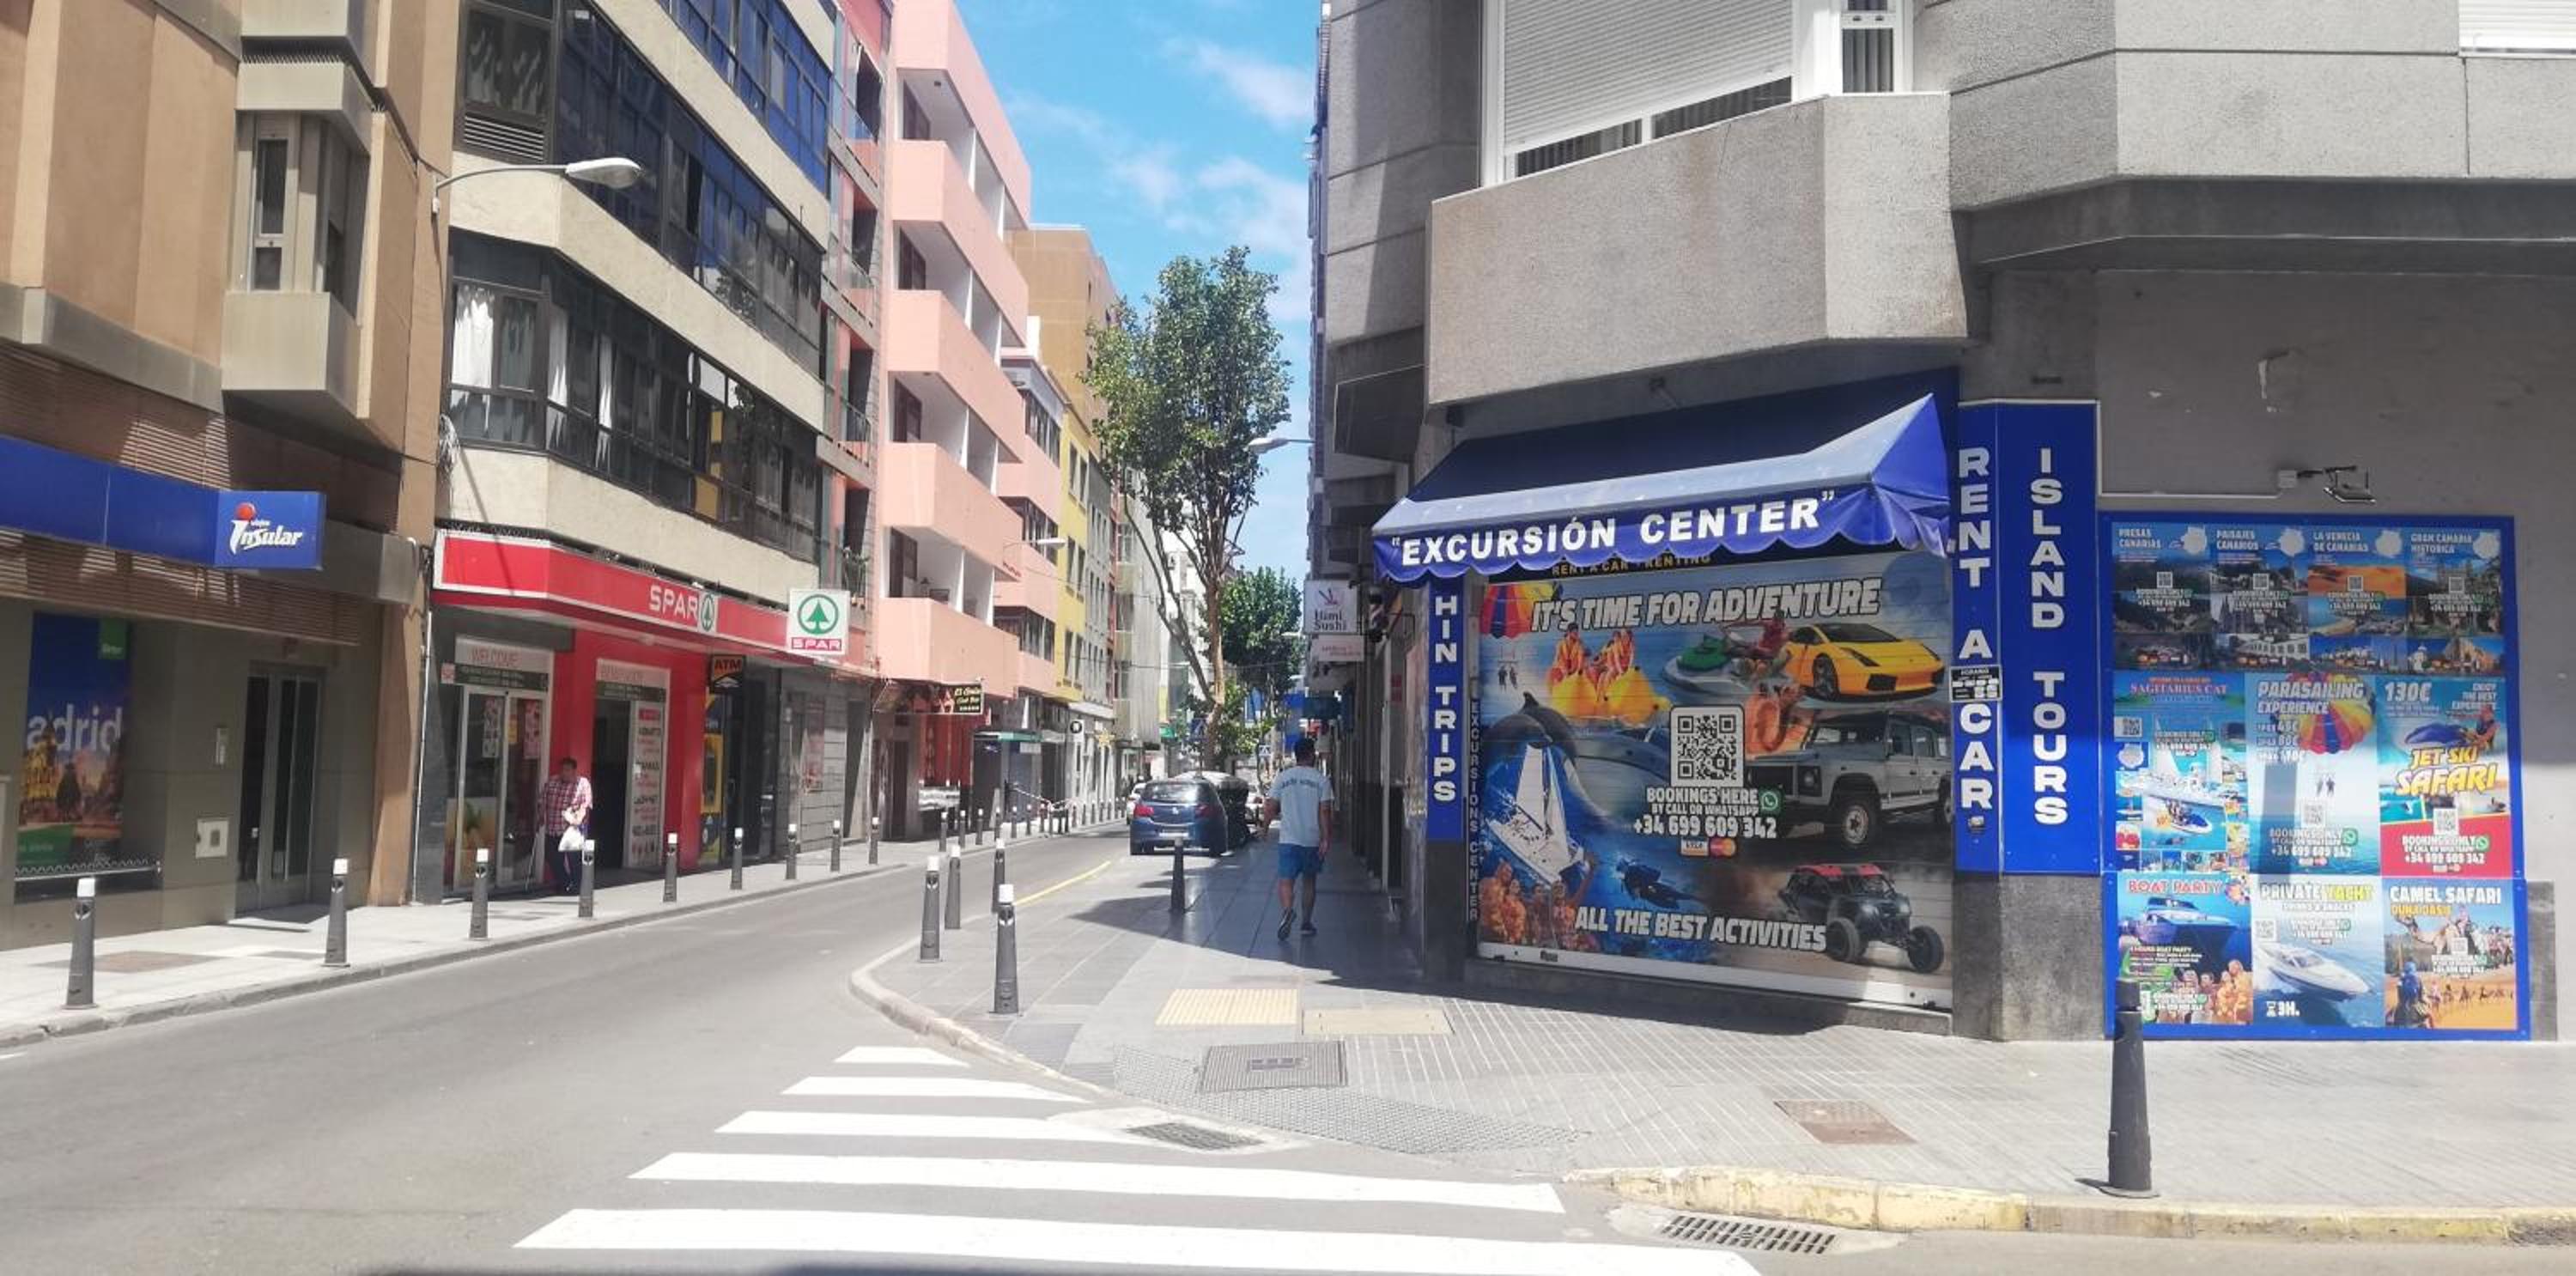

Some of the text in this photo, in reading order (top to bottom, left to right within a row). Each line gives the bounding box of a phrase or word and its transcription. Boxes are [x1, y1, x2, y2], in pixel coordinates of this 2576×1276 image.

[1959, 447, 1992, 587] RENT
[230, 519, 303, 555] Insular
[650, 585, 698, 620] SPAR
[1531, 577, 1883, 632] IT'S TIME FOR ADVENTURE
[1314, 619, 1347, 631] Sushi
[2030, 448, 2069, 824] ISLAND TOURS
[792, 637, 841, 650] SPAR
[1959, 629, 1993, 659] A
[714, 658, 742, 671] ATM
[2130, 683, 2227, 694] SAGITARIUS CAT
[2257, 681, 2364, 699] PARASAILING
[2385, 682, 2433, 702] 130€
[2257, 701, 2330, 714] EXPERIENCE
[1433, 686, 1457, 801] TRIPS
[1959, 703, 1995, 809] CAR
[2409, 745, 2479, 770] JET SKI
[2395, 763, 2499, 797] SAFARI
[1646, 787, 1759, 805] BOOKINGS HERE
[1468, 701, 1479, 921] EXCURSIONS CENTER
[1651, 804, 1759, 817] BY CALL OR WHATSAPP
[1634, 815, 1777, 839] +34 699 609 342
[2126, 878, 2224, 894] BOAT PARTY
[2259, 883, 2373, 901] PRIVATE YACHT
[2390, 886, 2501, 904] CAMEL SAFARI
[1575, 906, 1827, 952] ALL THE BEST ACTIVITIES
